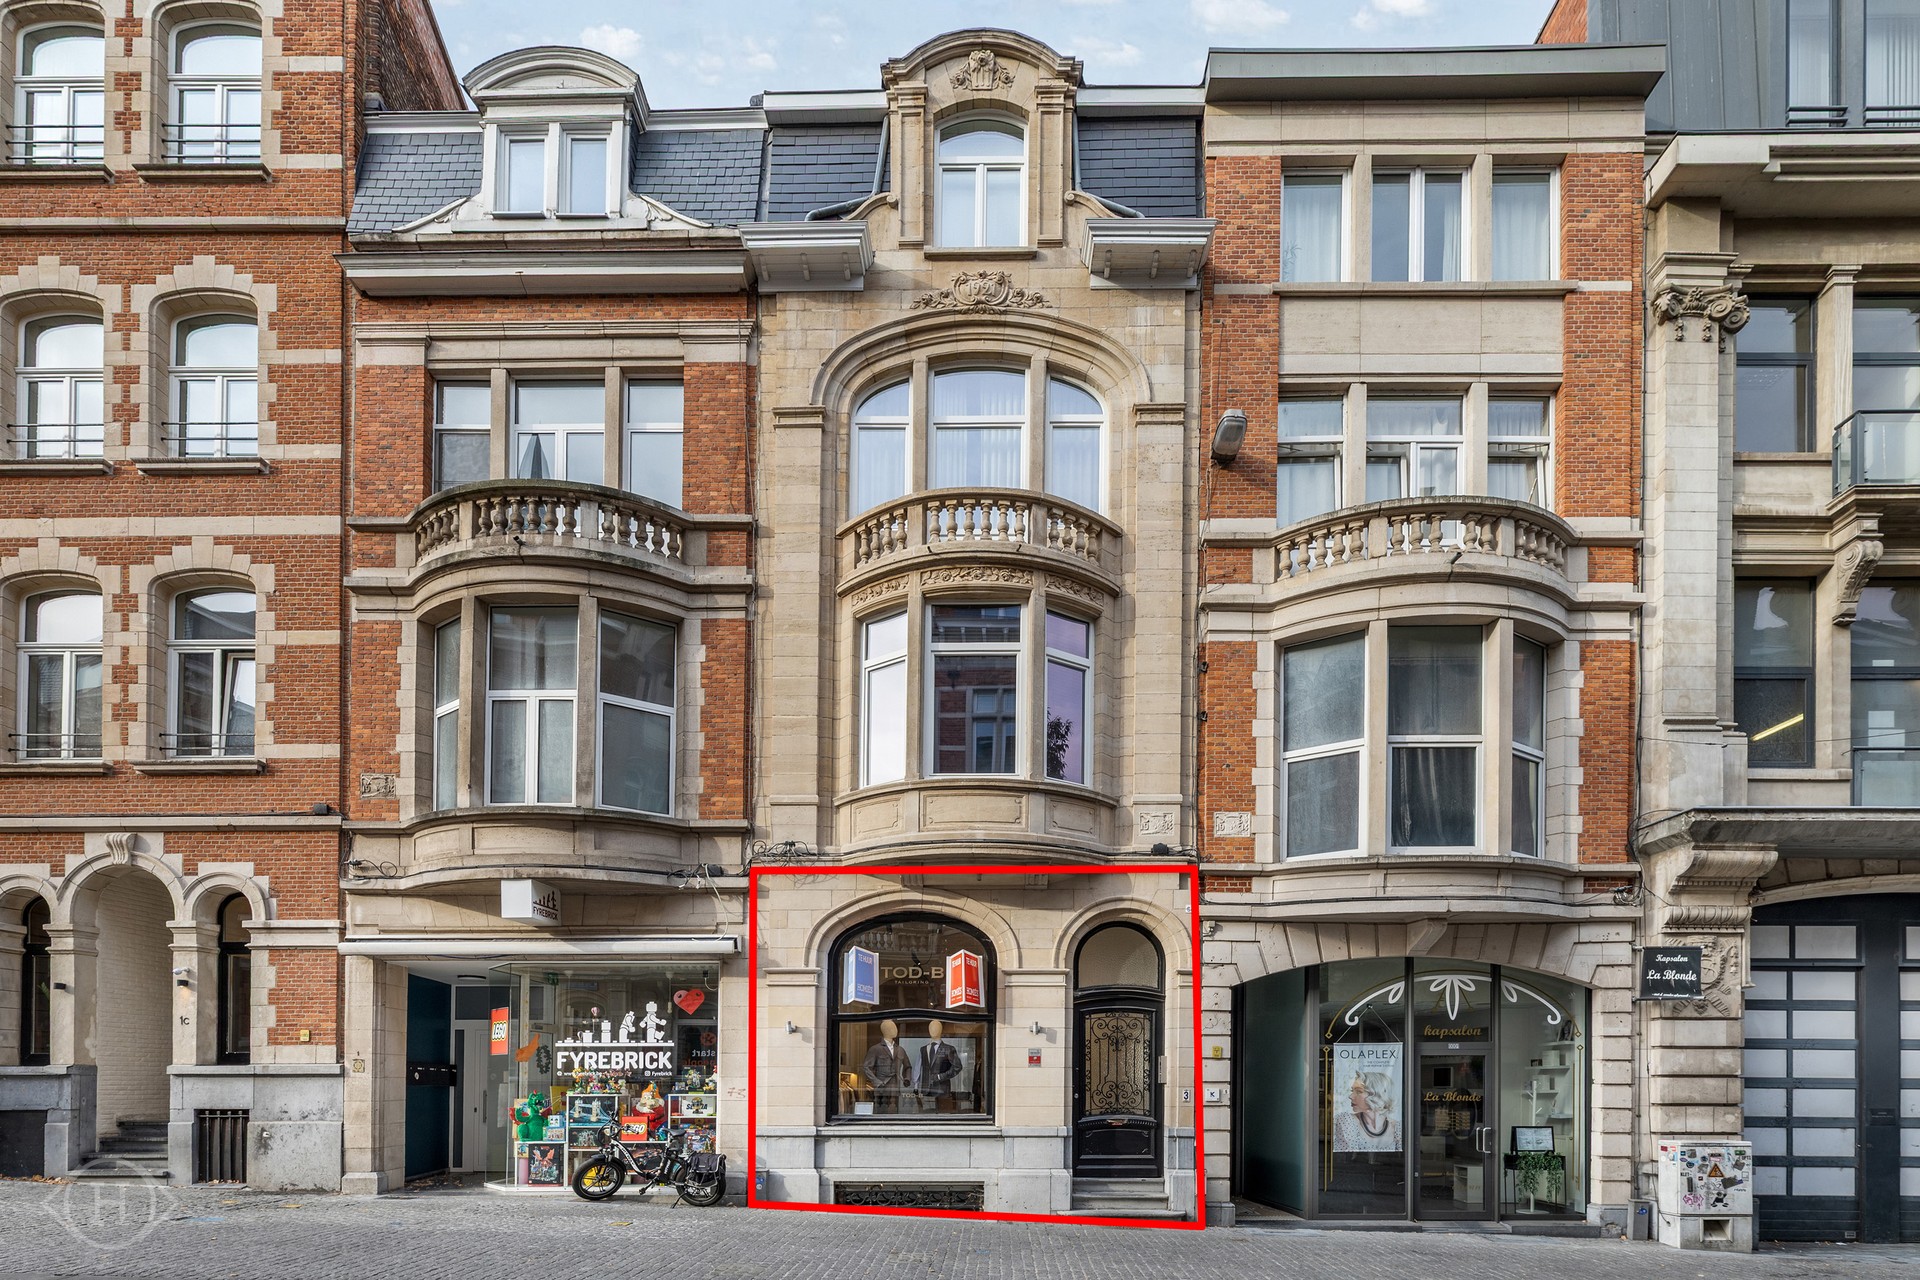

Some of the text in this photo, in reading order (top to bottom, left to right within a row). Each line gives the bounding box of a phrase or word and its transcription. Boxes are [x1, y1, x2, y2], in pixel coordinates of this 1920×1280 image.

[966, 282, 996, 297] 1921
[533, 906, 559, 920] FYREBRICK
[1656, 954, 1688, 963] Kapsalon
[881, 967, 944, 979] TOD-B
[1646, 970, 1697, 980] La Blonde
[492, 1021, 507, 1041] LEGO
[1424, 1025, 1481, 1039] kapsalon
[557, 1051, 672, 1069] FYREBRICK
[1183, 1091, 1189, 1100] 3
[1423, 1091, 1481, 1102] La Blonde
